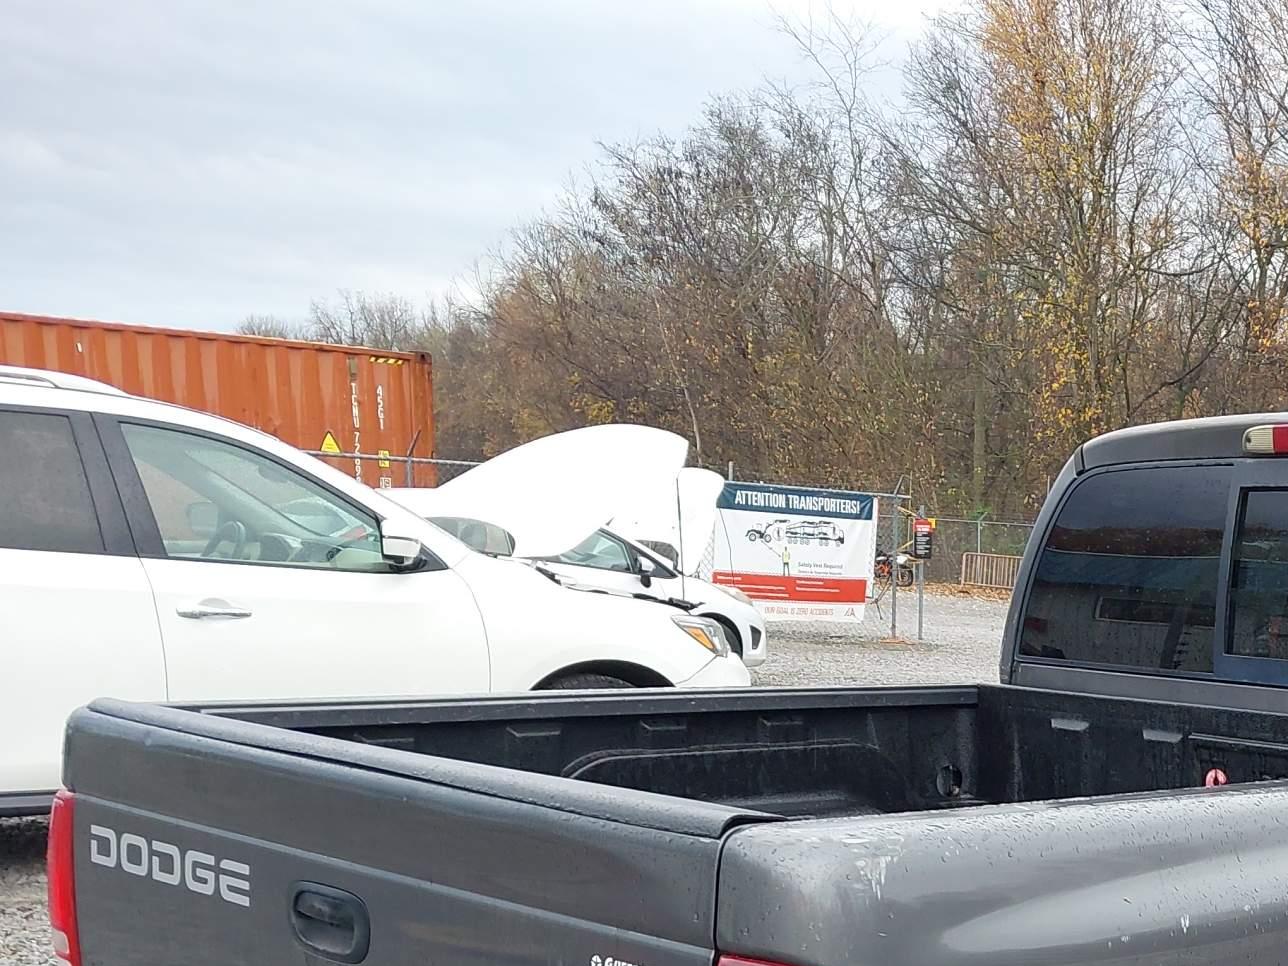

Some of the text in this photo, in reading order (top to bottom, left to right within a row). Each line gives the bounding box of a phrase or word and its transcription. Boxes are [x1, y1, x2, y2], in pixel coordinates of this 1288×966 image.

[735, 490, 860, 514] ATTENTION TRANSPORTERS!
[90, 824, 251, 907] DODGE
